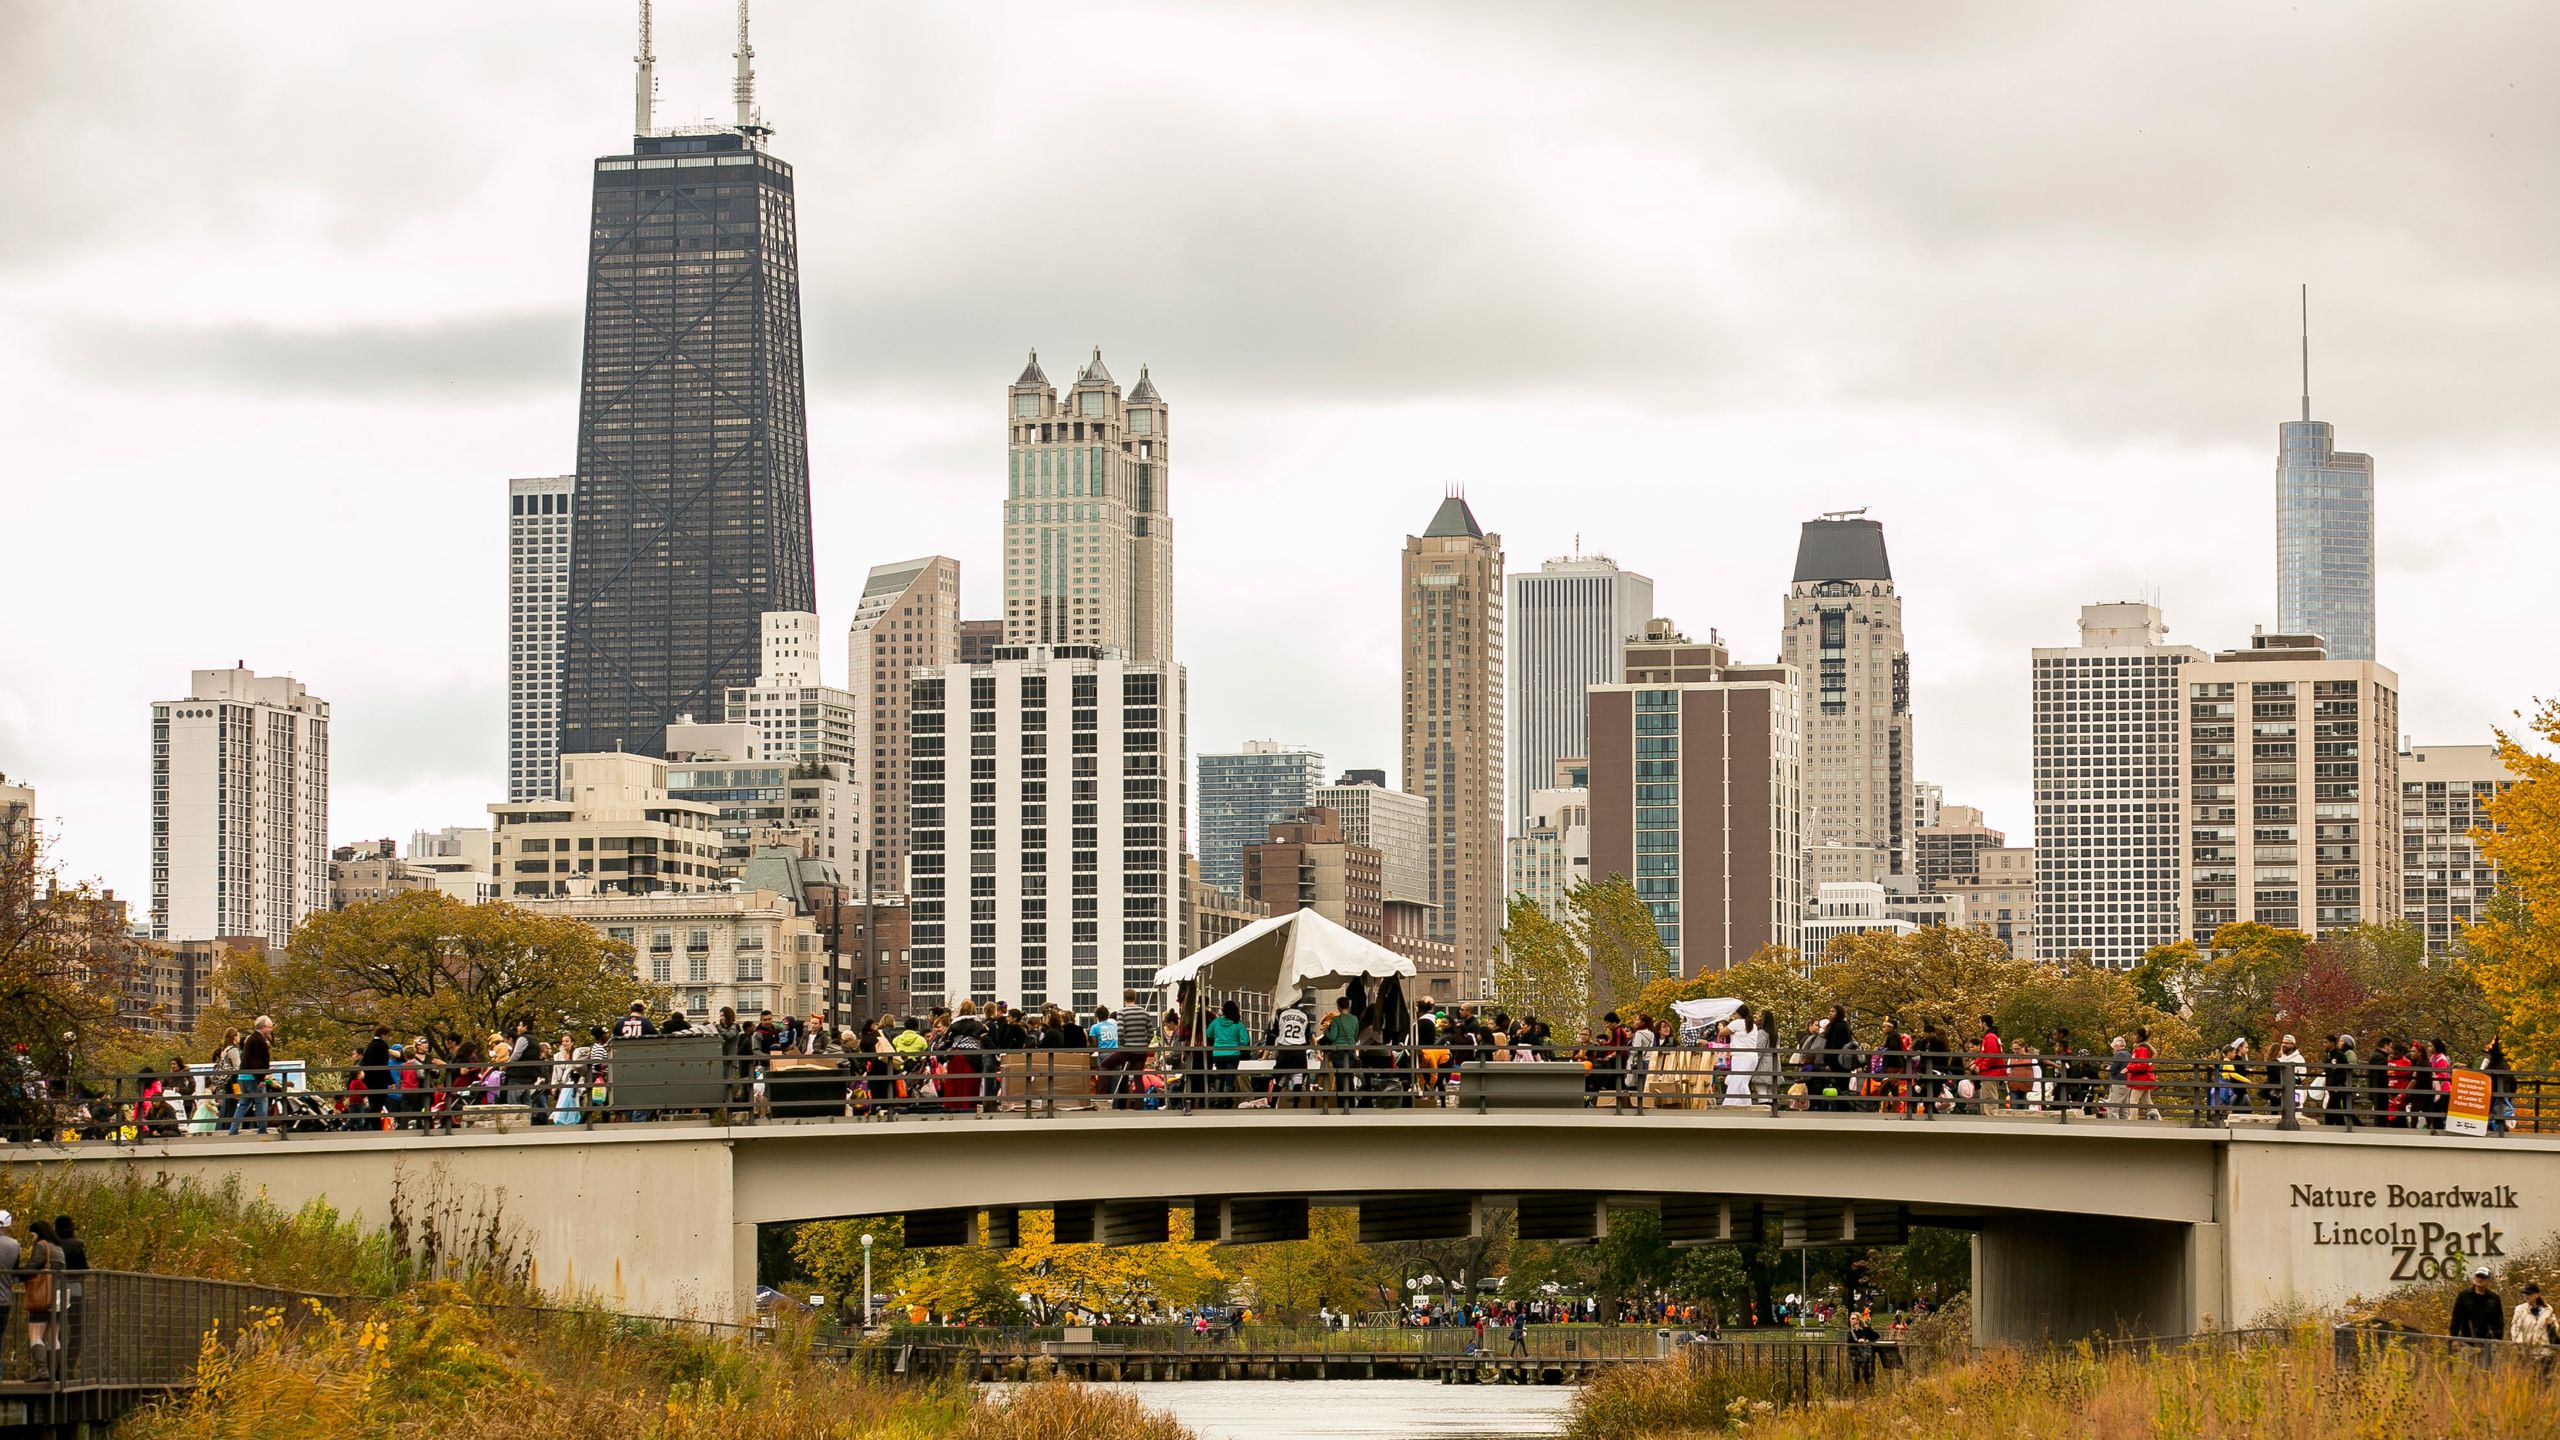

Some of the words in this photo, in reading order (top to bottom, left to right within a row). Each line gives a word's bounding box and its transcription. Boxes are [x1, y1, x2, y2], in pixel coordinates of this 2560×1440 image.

[1284, 1024, 1301, 1039] 22
[2290, 1183, 2376, 1207] Nature
[2387, 1184, 2519, 1208] Boardwalk
[2313, 1221, 2417, 1245] Lincoln
[2419, 1222, 2505, 1256] Park
[2390, 1246, 2463, 1281] Zoo
